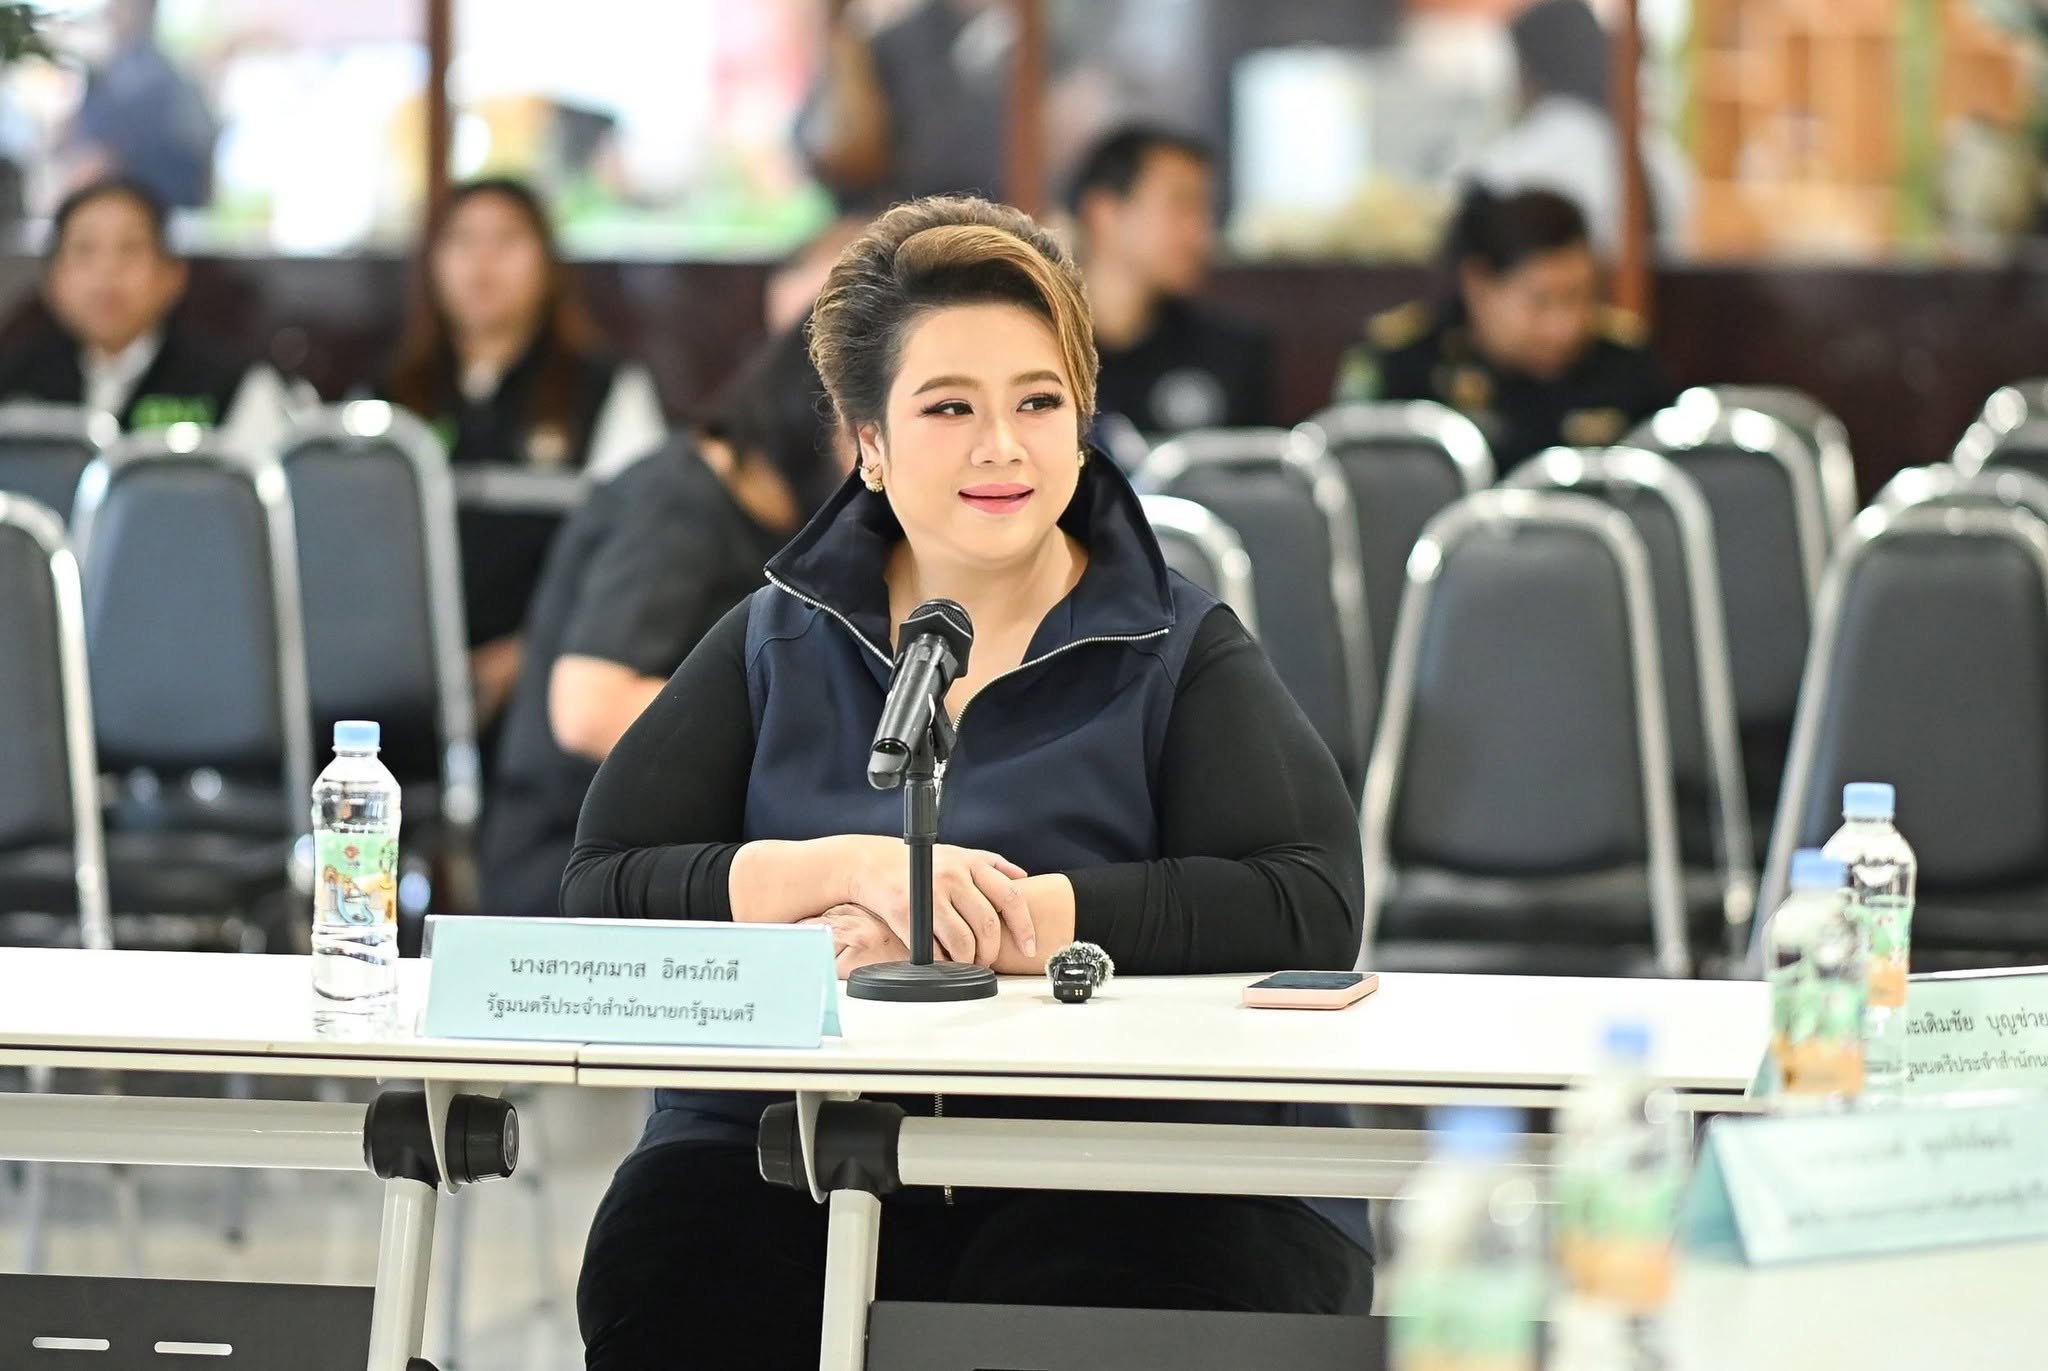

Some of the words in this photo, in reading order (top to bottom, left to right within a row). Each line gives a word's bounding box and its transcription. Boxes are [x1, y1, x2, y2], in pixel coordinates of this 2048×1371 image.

[510, 957, 647, 983] นางสาวศุภมาส
[661, 957, 740, 981] อิศรภักดี
[486, 991, 756, 1026] รัฐมนตรีประจำสำนักนายกรัฐมนตรี
